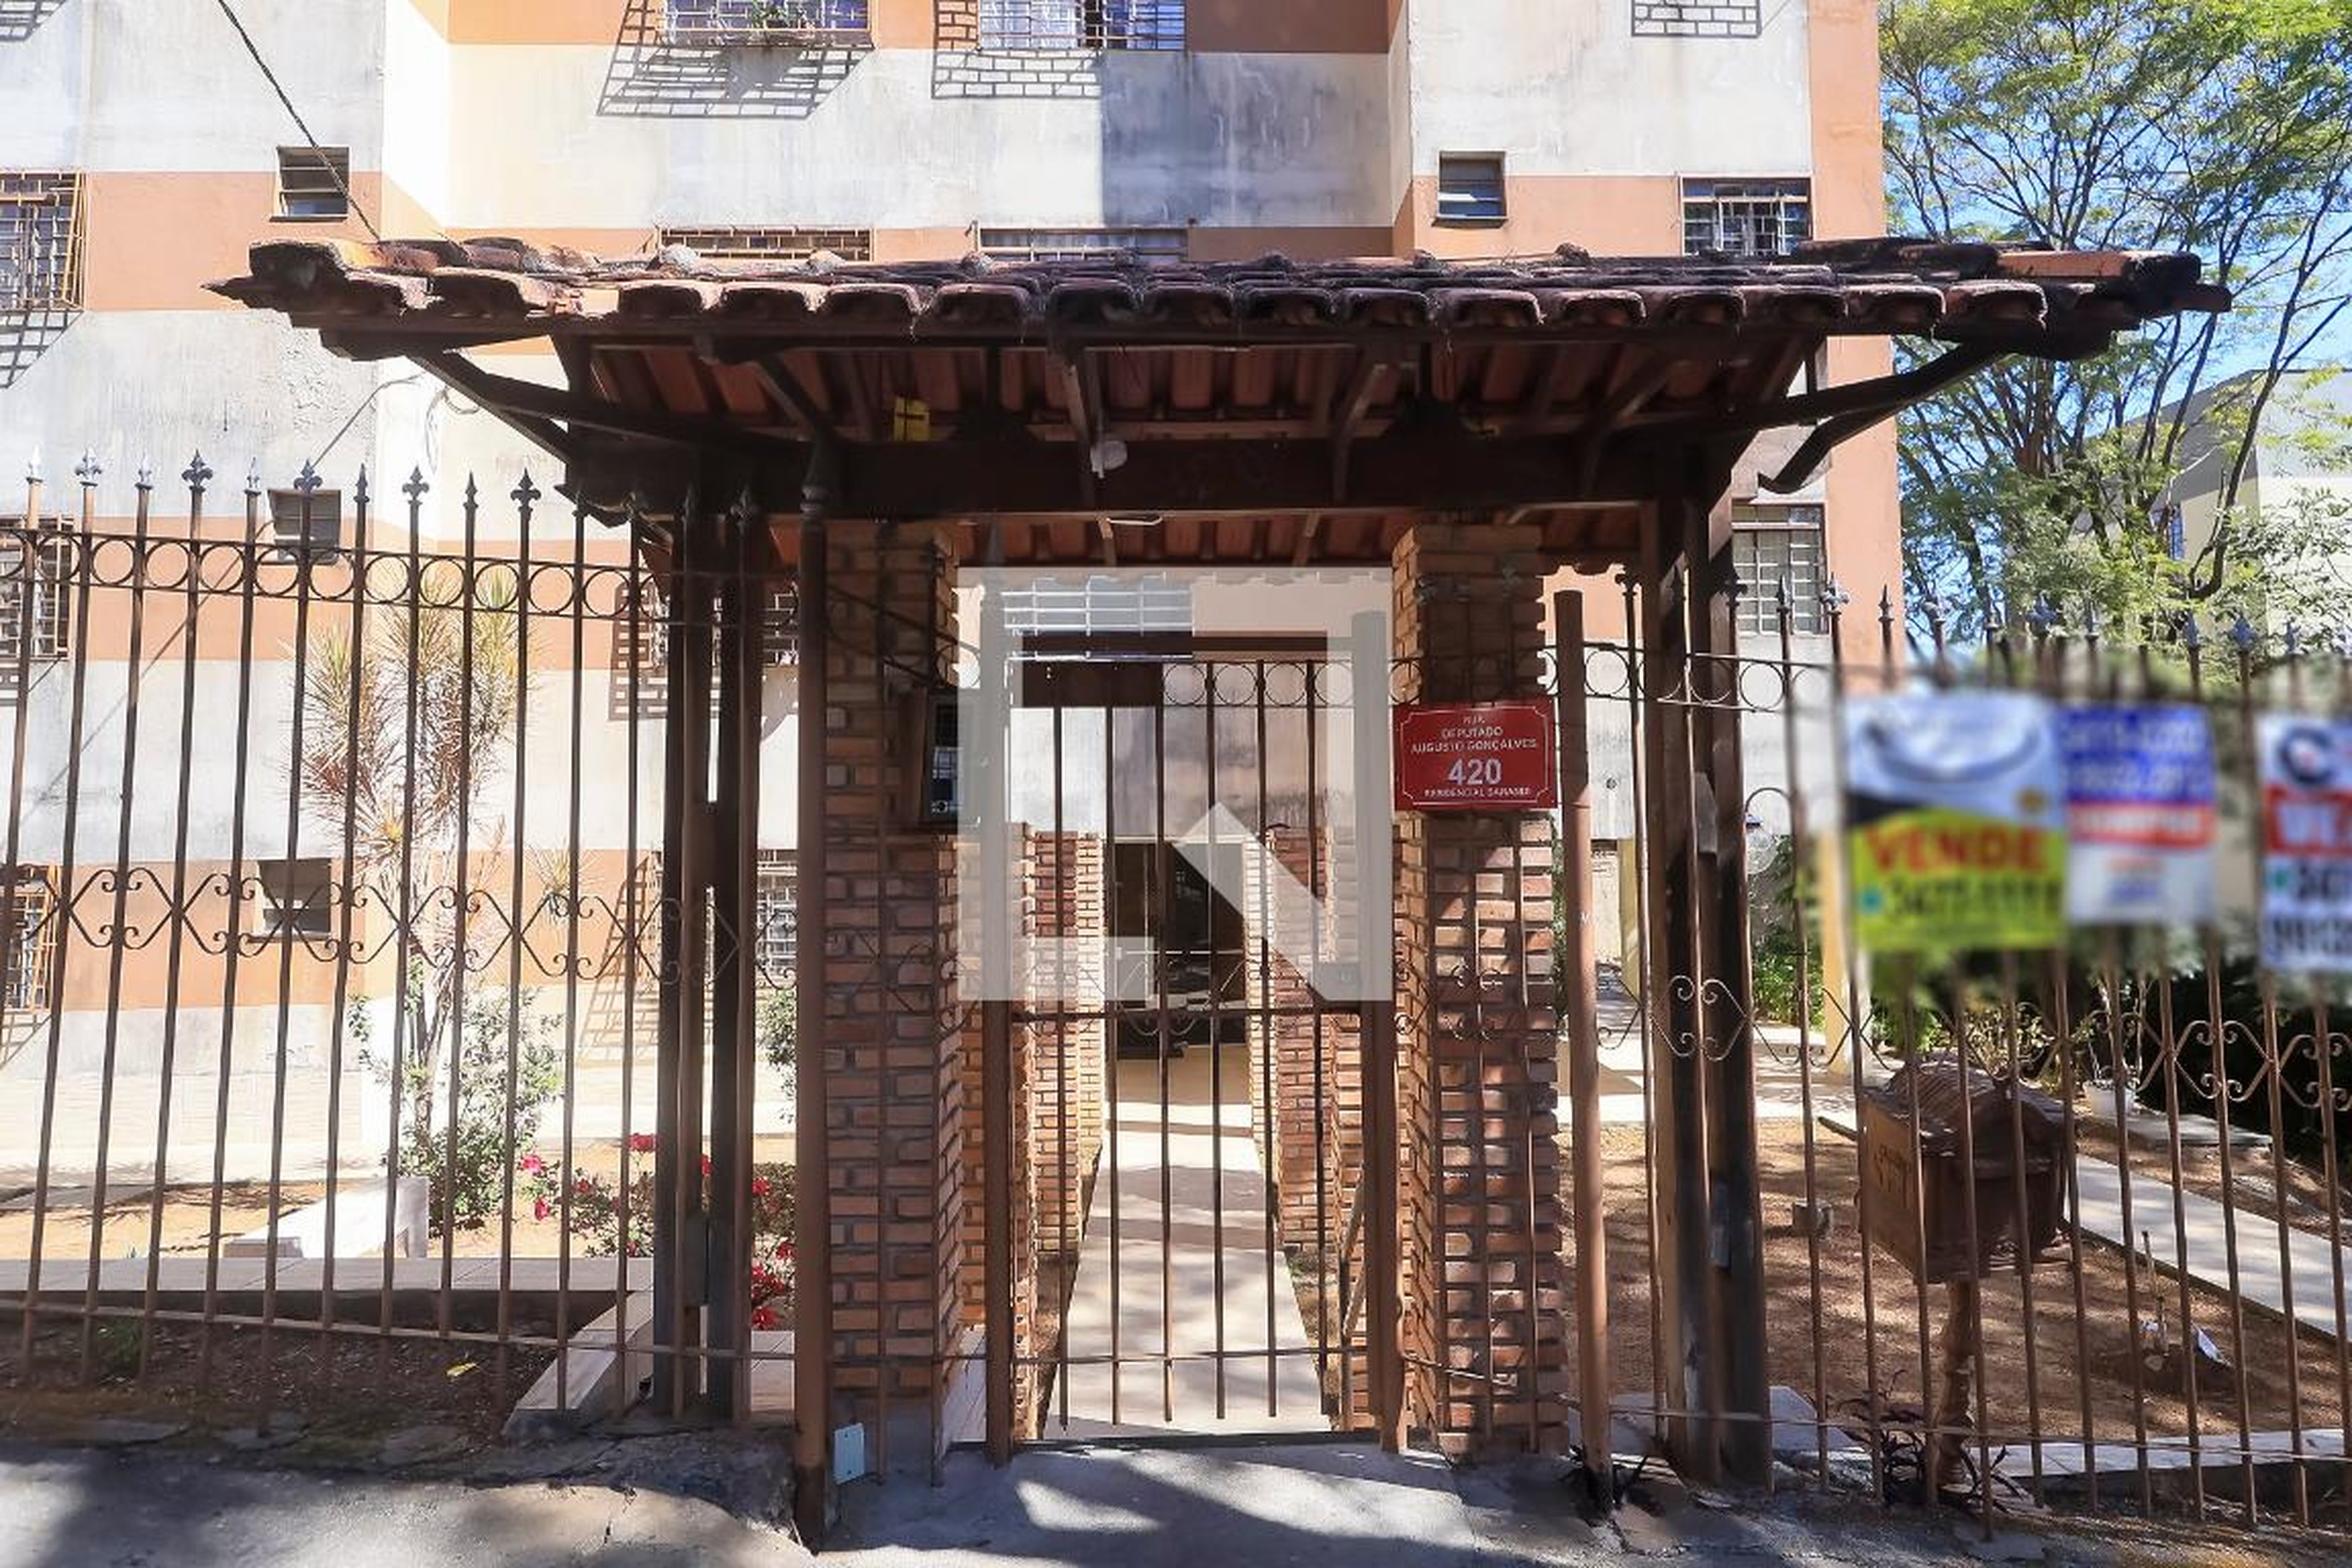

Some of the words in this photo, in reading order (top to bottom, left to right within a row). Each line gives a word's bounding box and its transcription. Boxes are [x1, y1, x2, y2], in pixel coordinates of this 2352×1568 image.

[1441, 726, 1503, 739] DEPUTADO
[1411, 741, 1464, 754] AUGUSTO
[1467, 737, 1537, 752] GONÇALVES
[1447, 758, 1502, 786] 420
